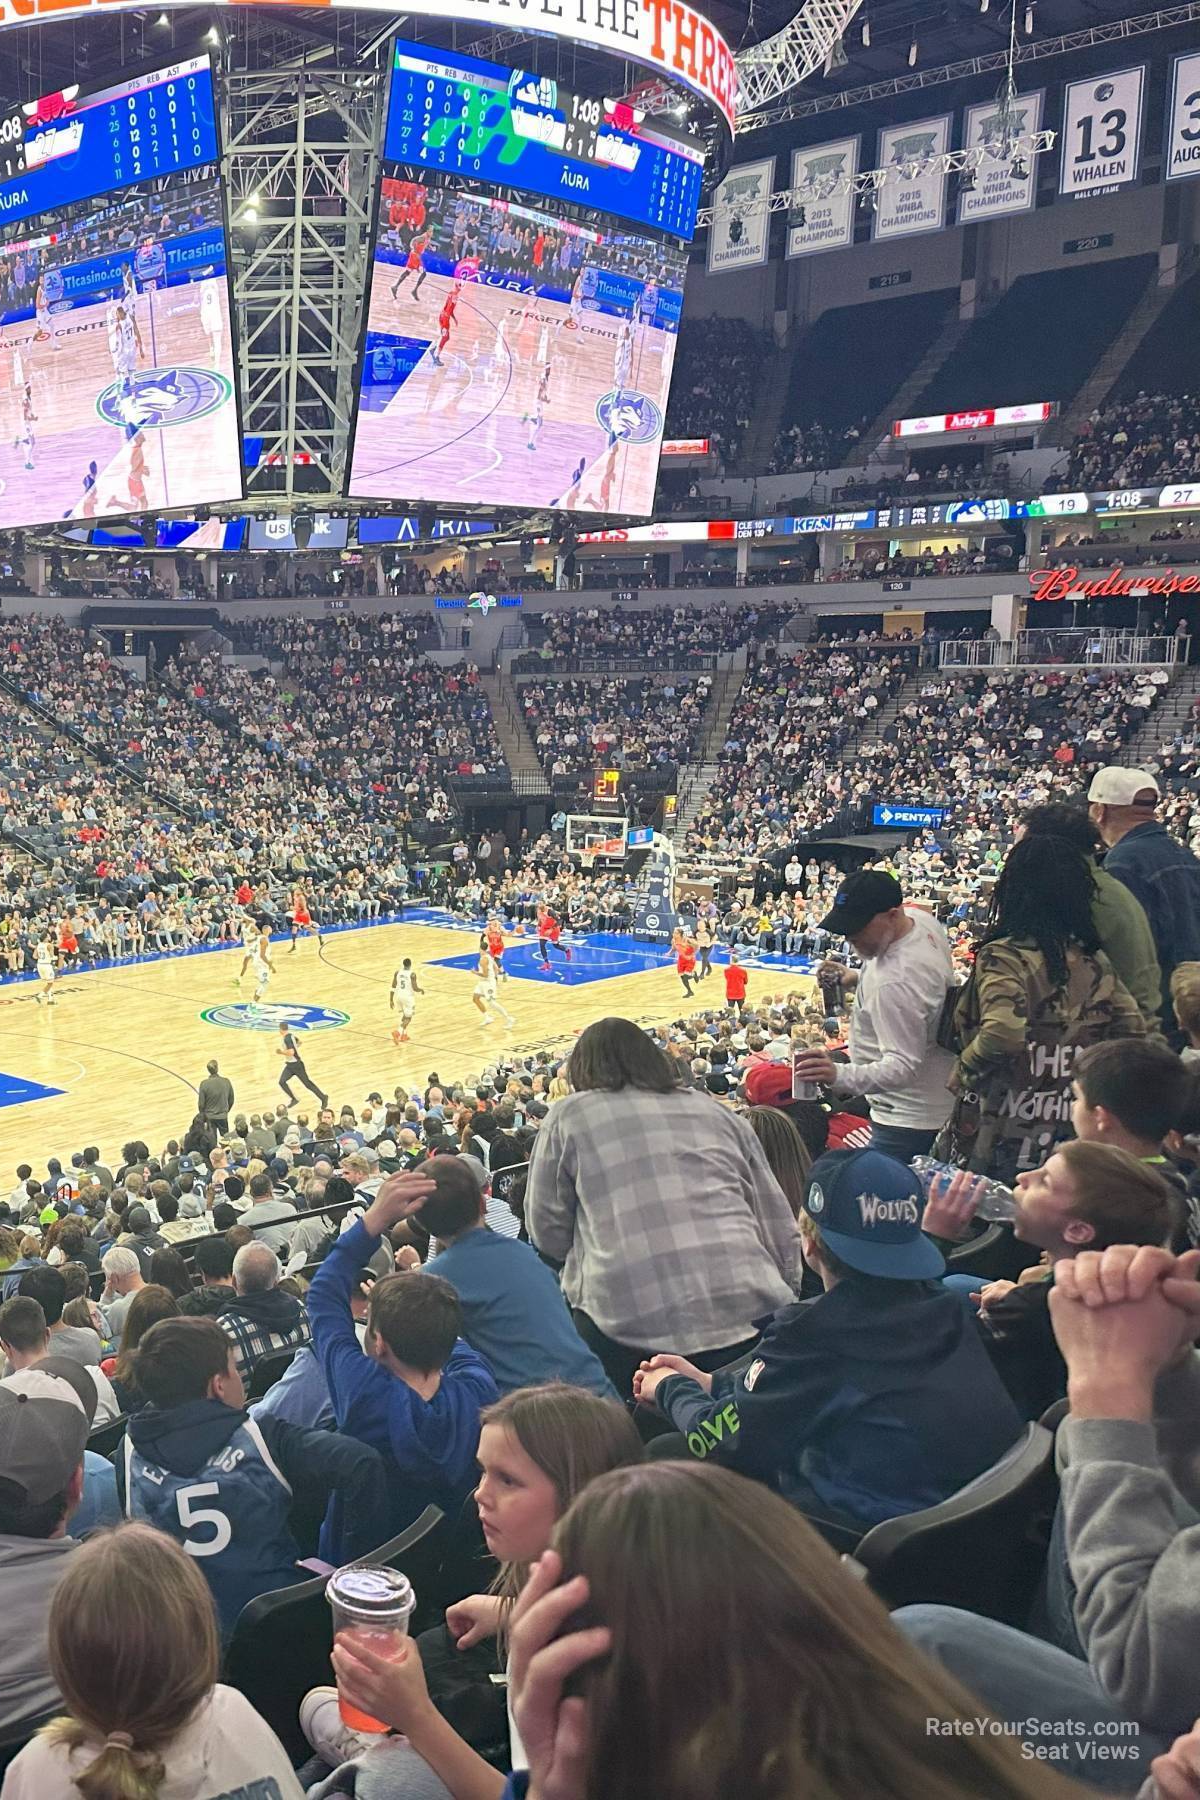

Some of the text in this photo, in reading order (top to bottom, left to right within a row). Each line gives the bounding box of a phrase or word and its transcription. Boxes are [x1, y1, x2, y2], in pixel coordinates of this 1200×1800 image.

[576, 0, 639, 40] THE
[128, 61, 199, 90] PTS REB AST PF
[427, 64, 474, 82] PTS REB AST
[410, 77, 487, 105] 1 0 0 0 0
[407, 93, 485, 122] 9 0 0 0 0
[572, 95, 600, 125] 1:08
[109, 121, 120, 132] 25
[402, 110, 483, 138] 23 2 1 1 0
[130, 129, 140, 142] 12
[192, 128, 199, 139] 0
[1074, 108, 1127, 164] 13
[566, 138, 594, 158] 6 1 6
[1173, 145, 1200, 164] AUG
[402, 144, 480, 170] 5 4 3 1 0
[6, 160, 12, 175] 1
[18, 158, 24, 170] 6
[1073, 160, 1126, 184] WHALEN
[986, 169, 1009, 182] 2017
[982, 180, 1012, 195] WNBA
[1074, 184, 1120, 200] HALL OF FAME
[899, 190, 921, 203] 2015
[967, 189, 1026, 210] CHAMPIONS
[811, 208, 832, 219] 2013
[895, 201, 923, 214] WNBA
[807, 218, 833, 231] WNBA
[881, 210, 937, 228] CHAMPIONS
[794, 227, 845, 245] CHAMPIONS
[1077, 238, 1099, 250] 220
[714, 245, 760, 262] CHAMPIONS
[879, 274, 899, 287] 219
[950, 412, 988, 428] Arby's
[1058, 490, 1193, 511] 19 1:08 27
[268, 521, 286, 534] us
[738, 521, 766, 530] CLE 101
[793, 515, 832, 533] KFAN
[738, 530, 753, 538] DEN
[1029, 566, 1200, 601] Budweise
[894, 811, 942, 823] PENTA
[635, 928, 669, 937] CFMOTO
[400, 980, 406, 989] 5
[687, 1402, 741, 1459] OLVE
[175, 1481, 232, 1557] 5
